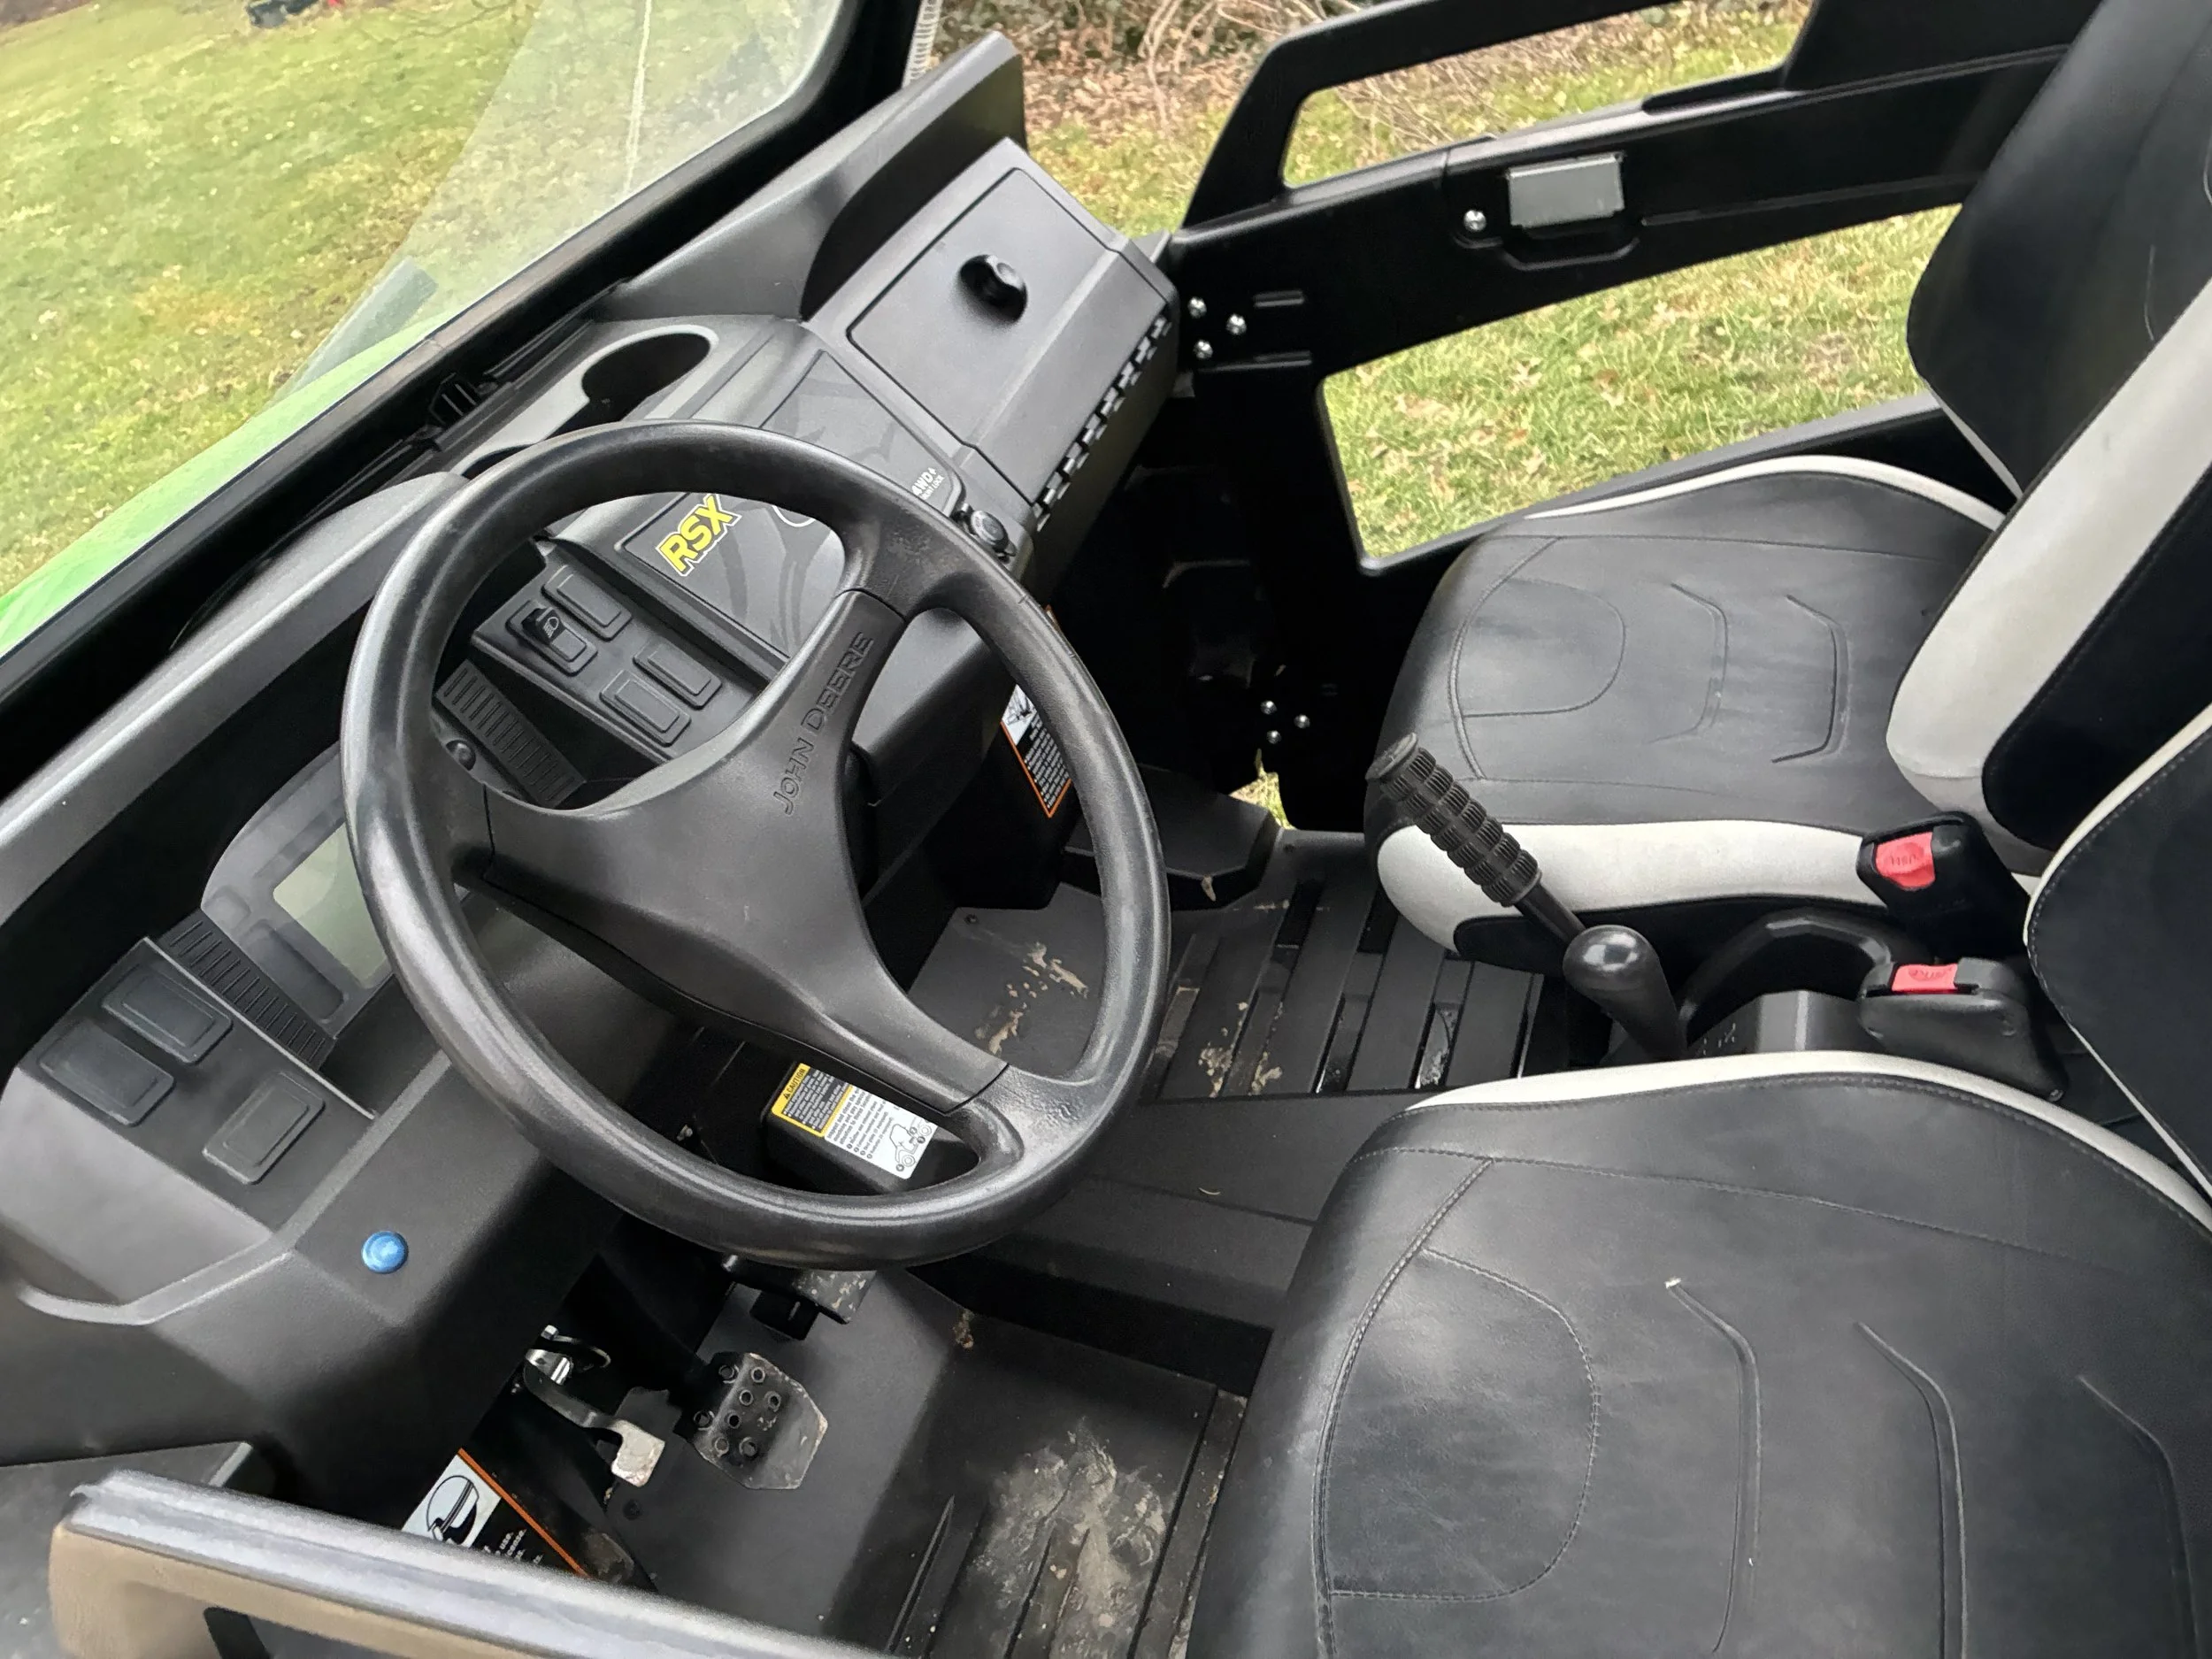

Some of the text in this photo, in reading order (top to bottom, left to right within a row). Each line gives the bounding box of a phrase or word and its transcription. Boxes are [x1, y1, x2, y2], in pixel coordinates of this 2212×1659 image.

[657, 495, 741, 576] RSX
[772, 631, 874, 813] JOHN DEERE
[787, 1068, 805, 1093] CAUTION
